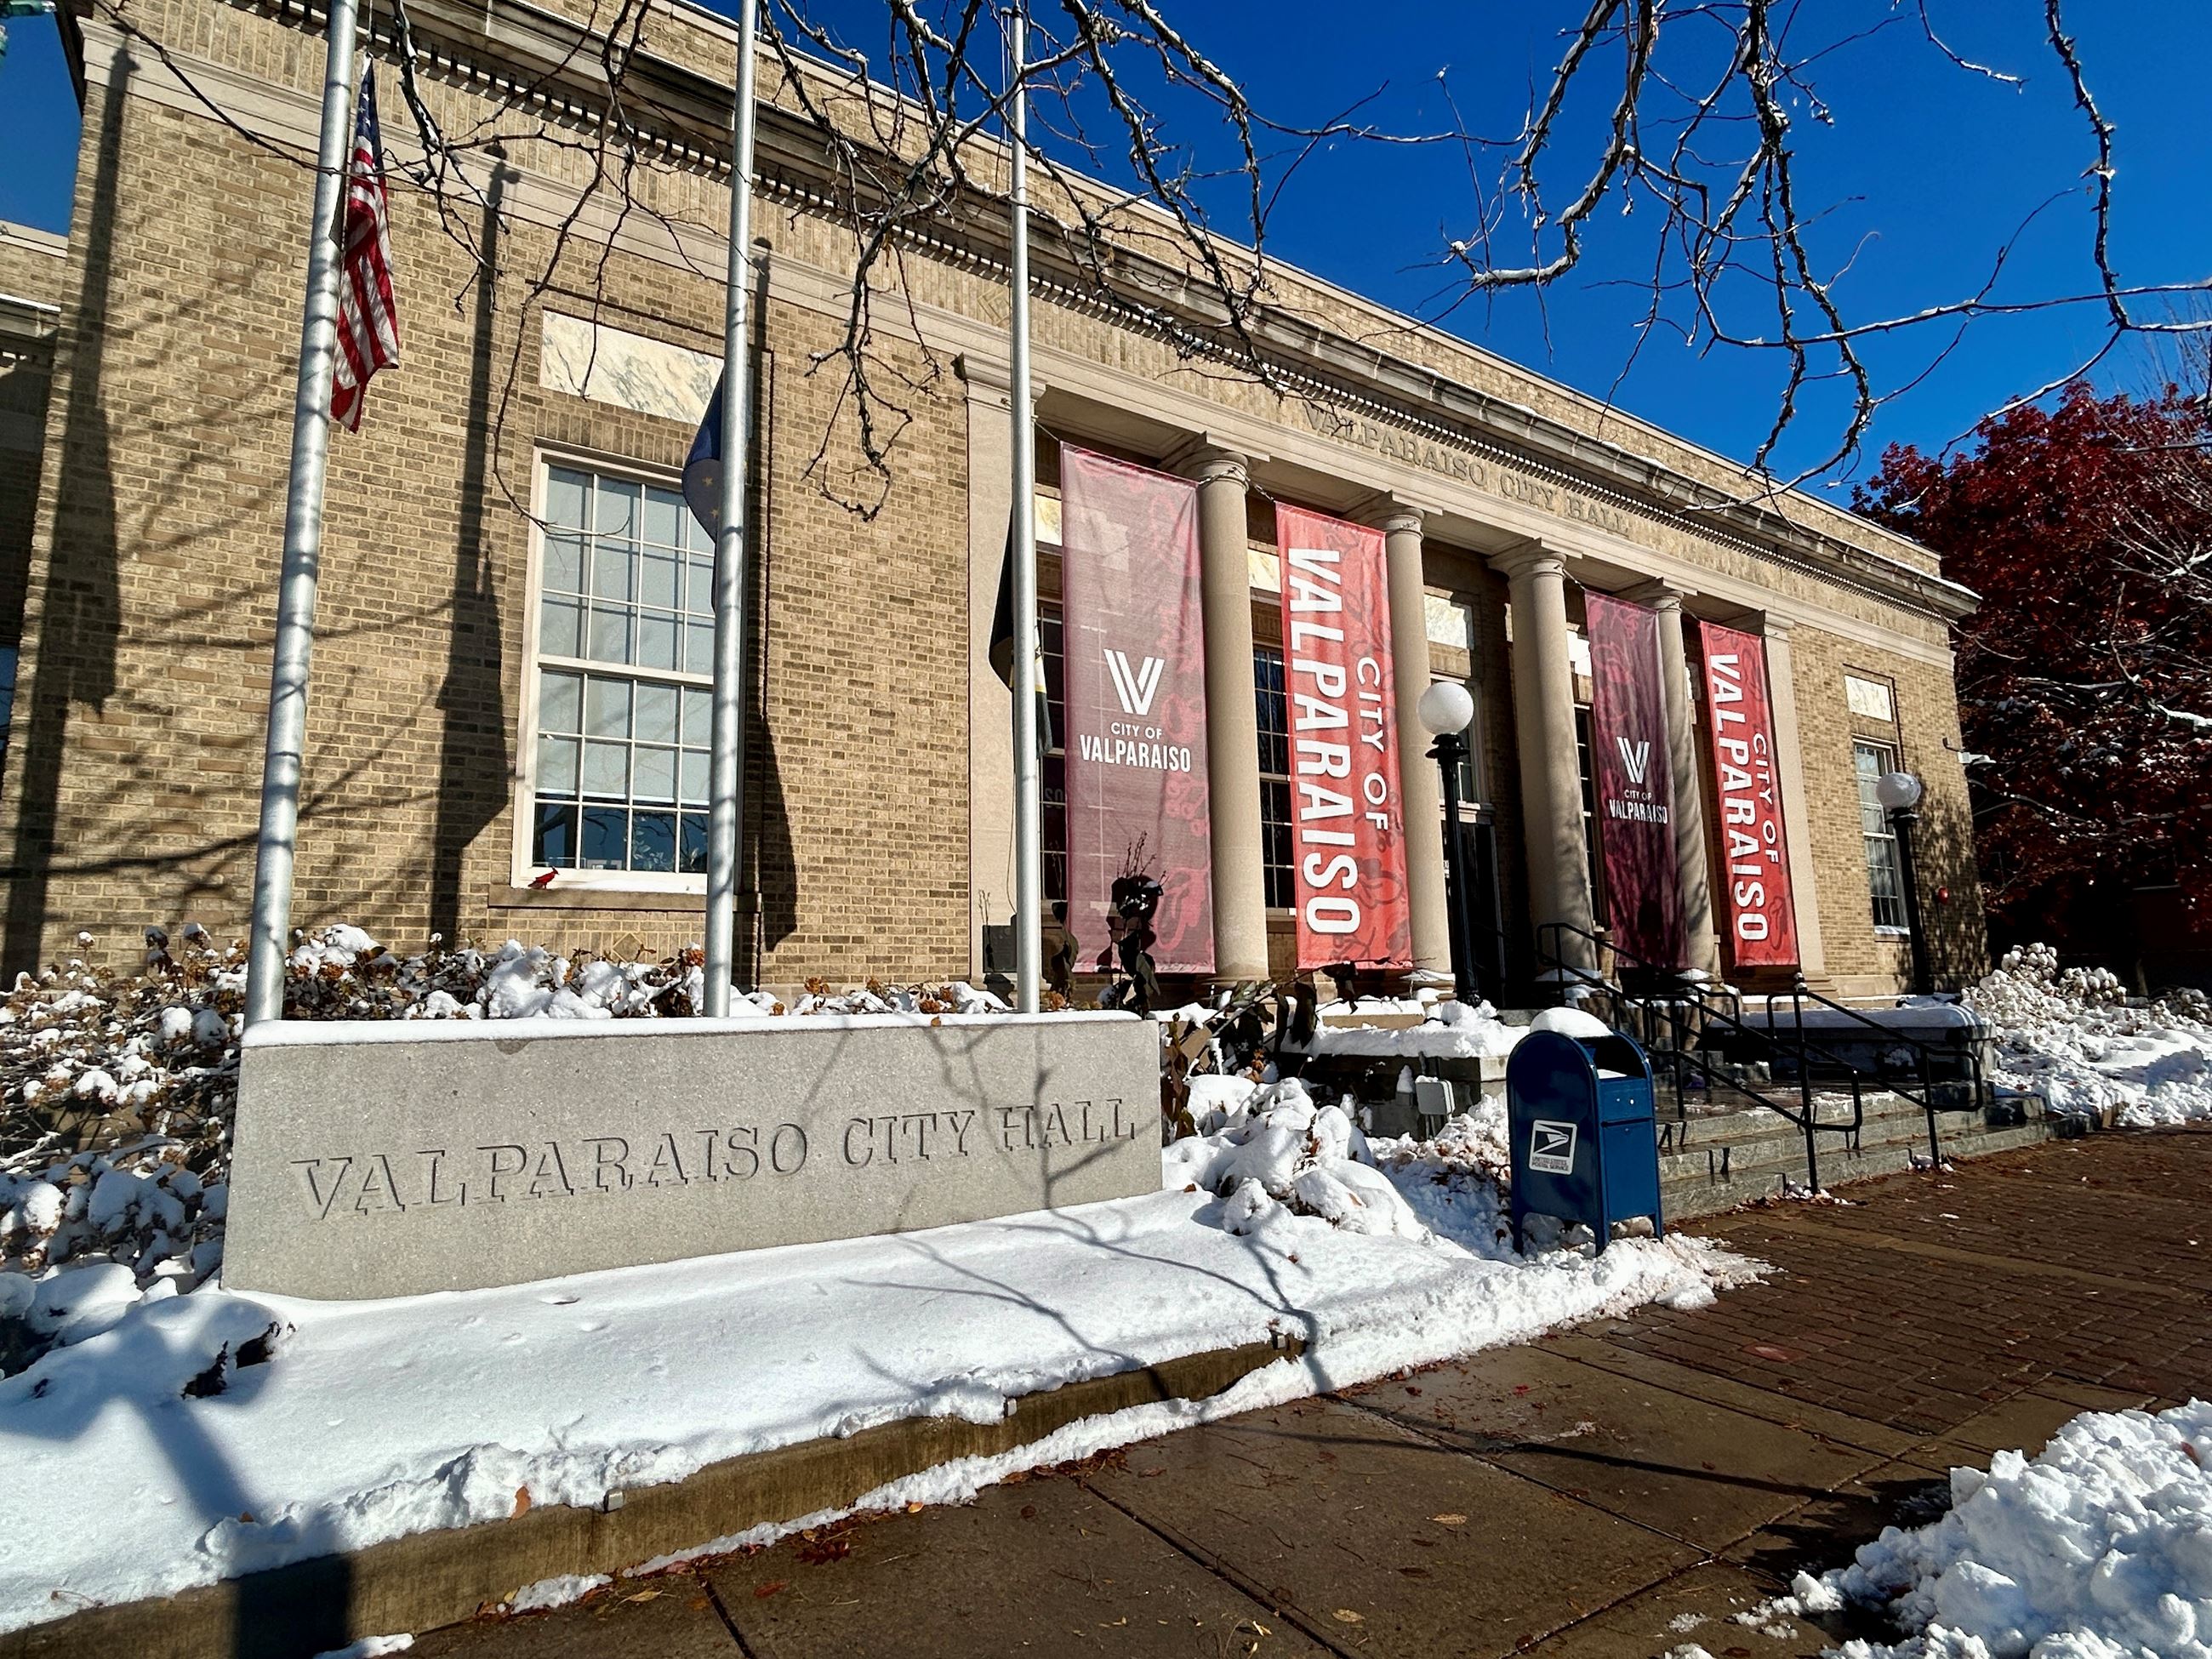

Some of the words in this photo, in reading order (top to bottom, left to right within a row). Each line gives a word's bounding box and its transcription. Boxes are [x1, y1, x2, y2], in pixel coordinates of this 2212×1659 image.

[1302, 401, 1485, 487] VALPARAISO
[1500, 473, 1557, 511] CITY
[1567, 494, 1630, 538] HALL
[1080, 734, 1192, 772] VALPARAISO
[1110, 721, 1140, 738] CITY
[1145, 727, 1163, 740] OF
[1287, 547, 1360, 934] VALPARAISO
[1356, 656, 1386, 755] CITY
[1362, 772, 1388, 831] OF
[1609, 798, 1668, 824] VALPARAISO
[1623, 789, 1640, 800] CITY
[1641, 791, 1653, 801] OF
[1709, 653, 1769, 942] VALPARAISO
[1751, 732, 1773, 806] CITY
[1762, 818, 1779, 865] OF
[290, 1122, 808, 1220] VALPARAISO
[842, 1109, 976, 1169] CITY
[994, 1098, 1136, 1152] HALL
